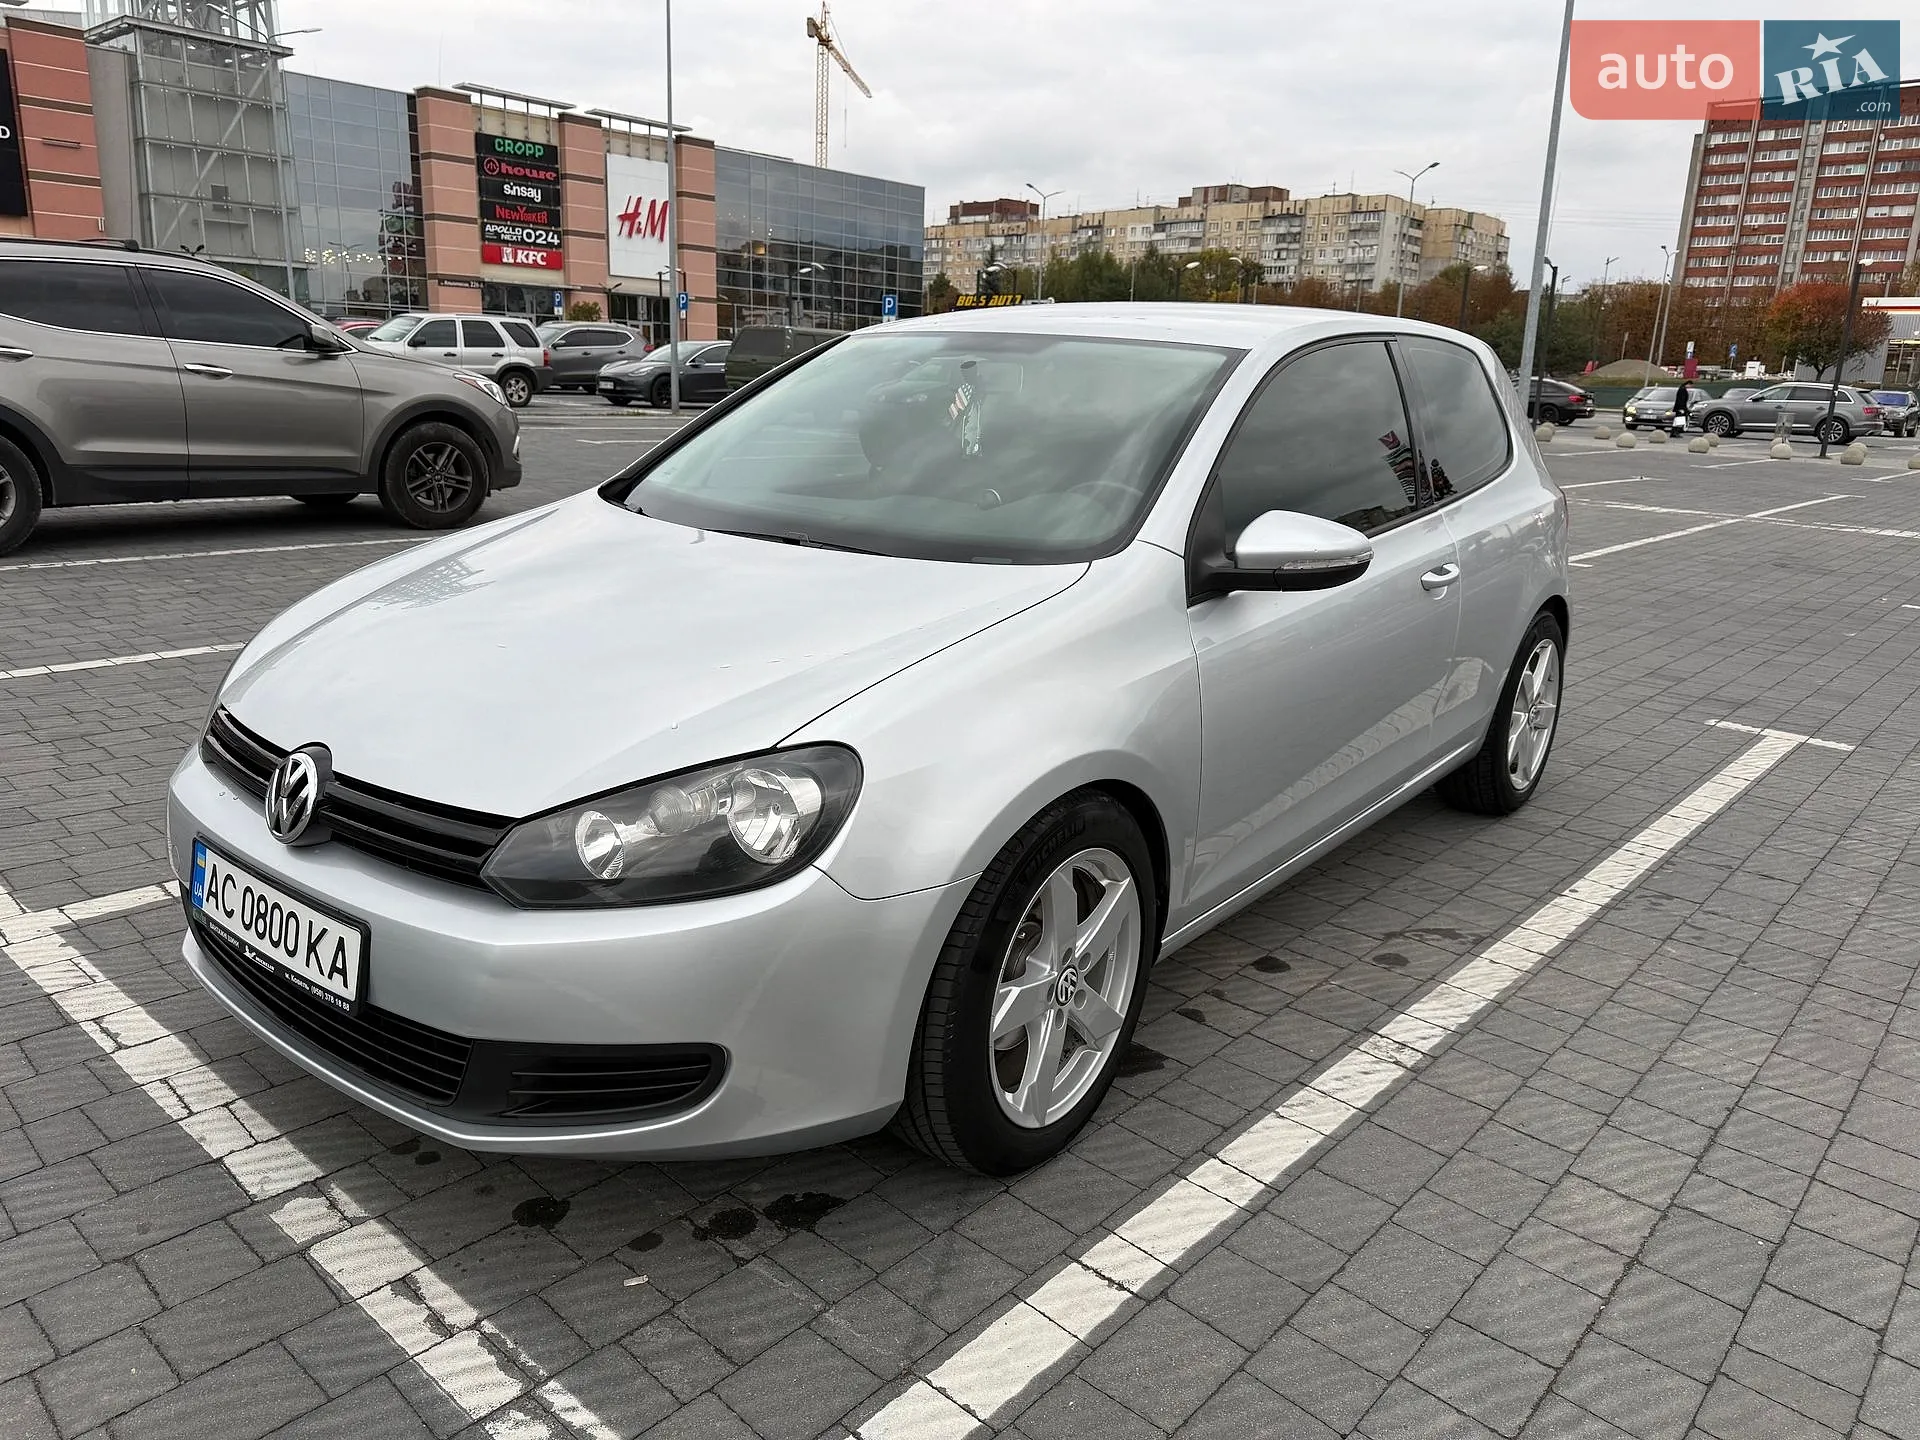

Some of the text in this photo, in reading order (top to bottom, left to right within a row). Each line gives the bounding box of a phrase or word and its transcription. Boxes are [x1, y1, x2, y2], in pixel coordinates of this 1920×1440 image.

[495, 138, 544, 158] CROPP
[503, 182, 541, 202] sinsay
[617, 195, 669, 242] H&M
[485, 224, 522, 235] APOLLO
[501, 234, 522, 242] NEXT
[516, 249, 547, 266] KFC
[885, 297, 894, 314] P
[194, 881, 203, 899] UA
[205, 863, 349, 990] AC 0800 KA
